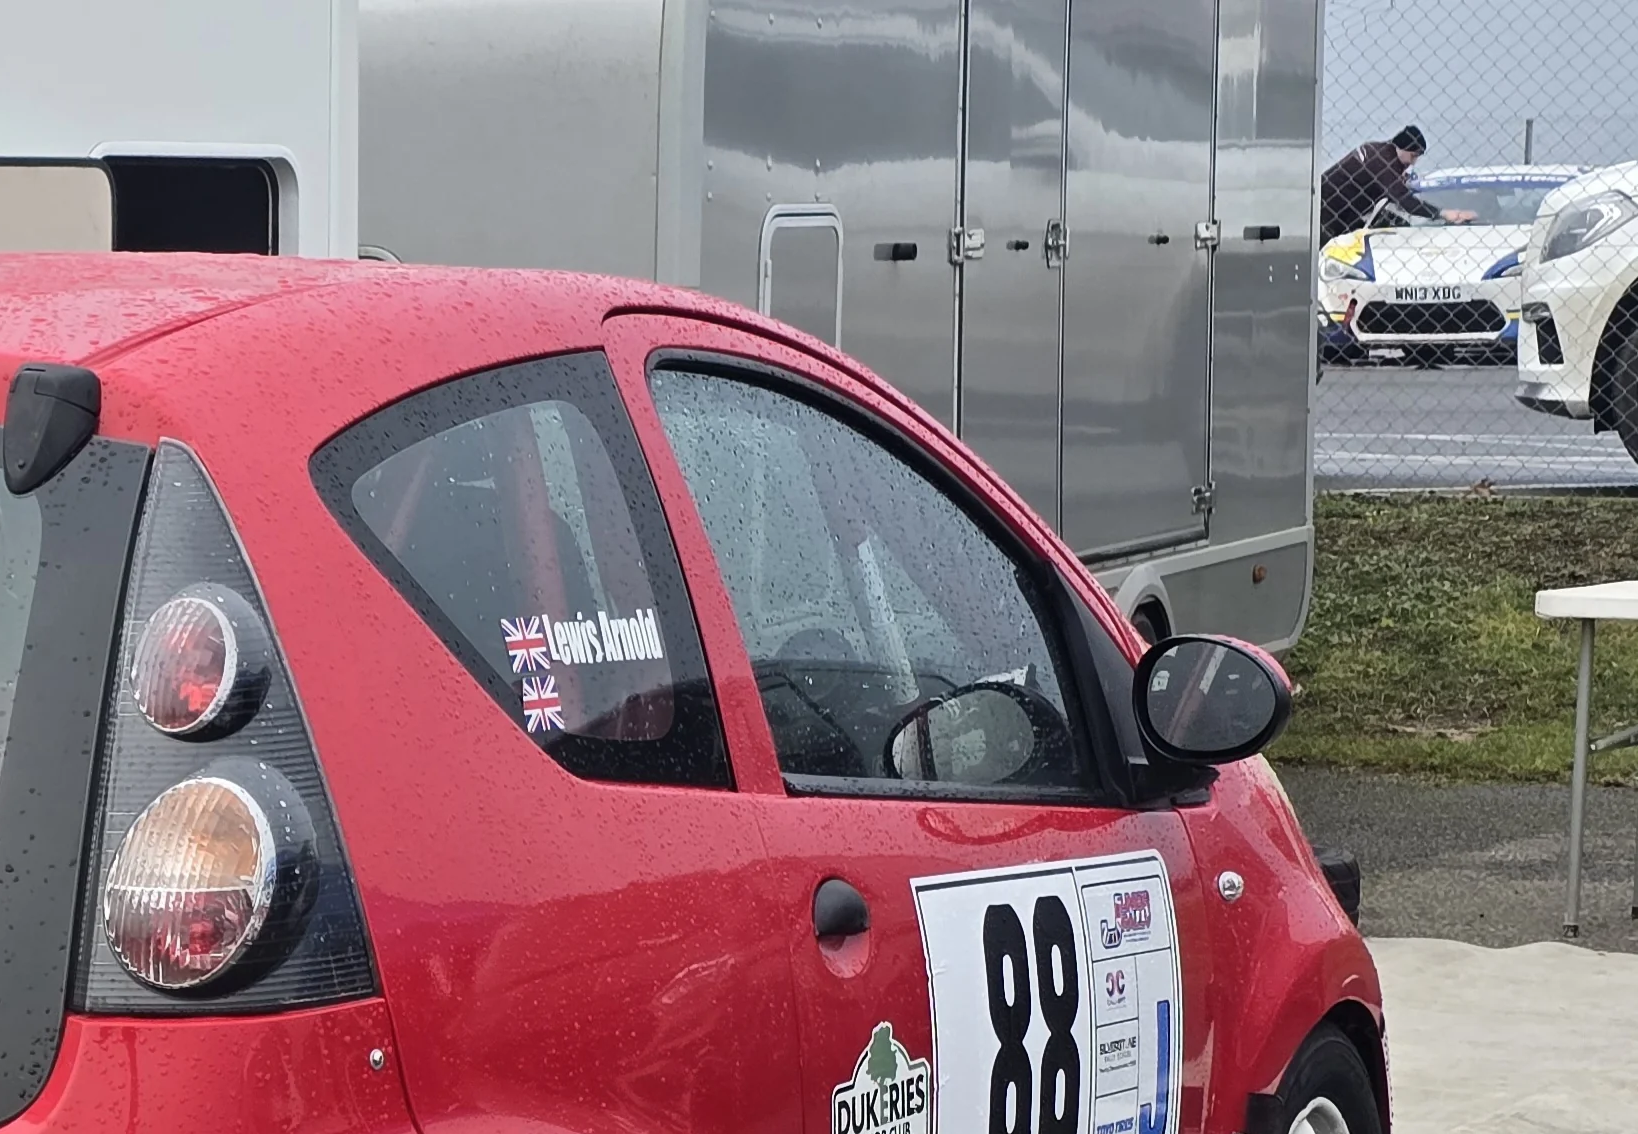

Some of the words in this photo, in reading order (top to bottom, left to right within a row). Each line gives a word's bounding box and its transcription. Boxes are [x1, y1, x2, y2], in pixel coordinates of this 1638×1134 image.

[1395, 286, 1428, 300] WN13
[542, 611, 604, 665] Lewis
[597, 608, 663, 662] Arnold
